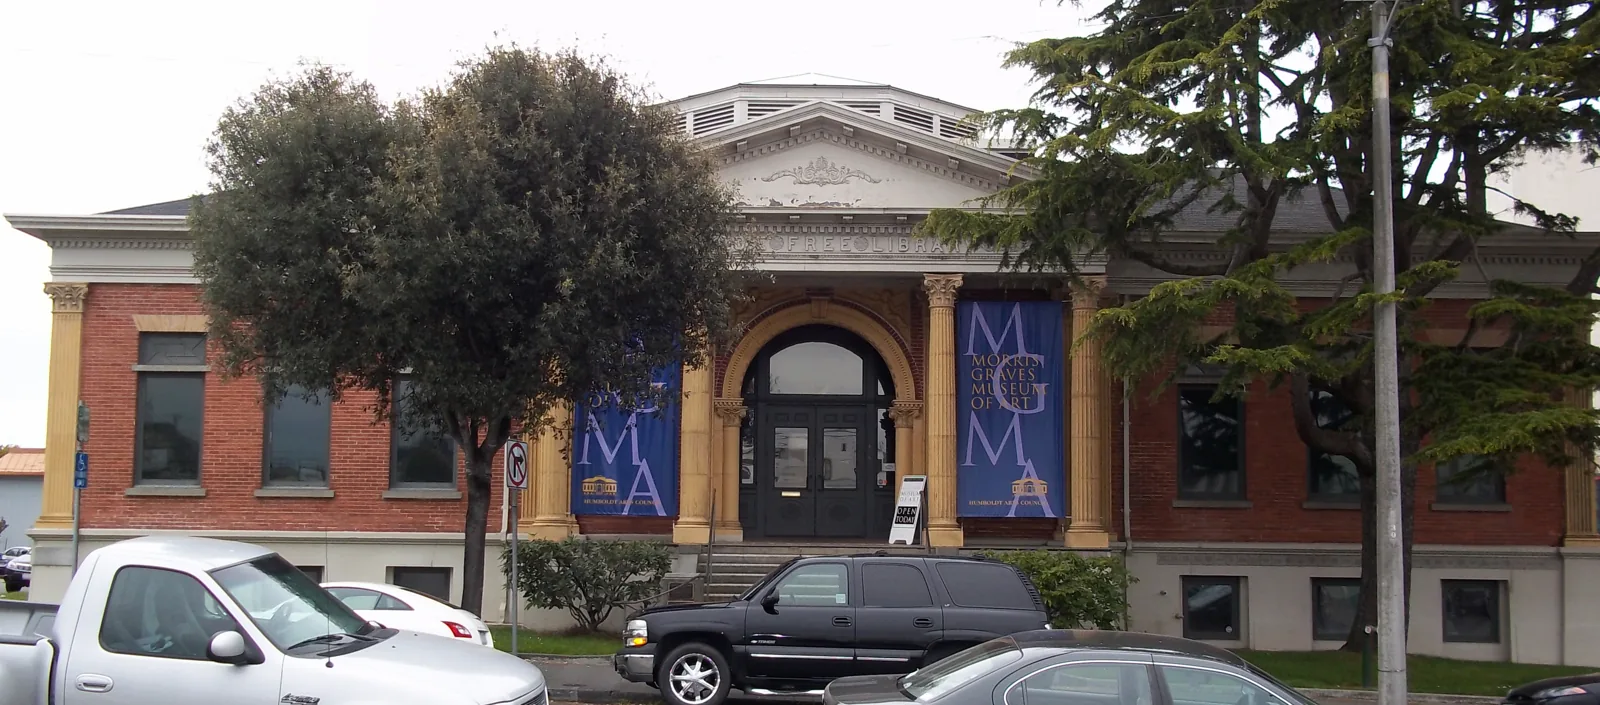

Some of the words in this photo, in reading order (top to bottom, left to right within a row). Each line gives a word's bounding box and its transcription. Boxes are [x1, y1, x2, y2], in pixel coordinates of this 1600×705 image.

[787, 236, 851, 252] FREE
[872, 236, 973, 253] LIBRAY
[972, 354, 1039, 367] MORRIS
[971, 368, 1035, 381] GRAVES
[972, 382, 1047, 396] MUSEUM
[971, 397, 993, 410] OF
[999, 397, 1031, 410] ART
[960, 410, 1027, 466] M
[622, 458, 667, 516] A
[1005, 458, 1057, 517] A
[897, 507, 917, 515] OPEN
[895, 515, 915, 523] TODAY
